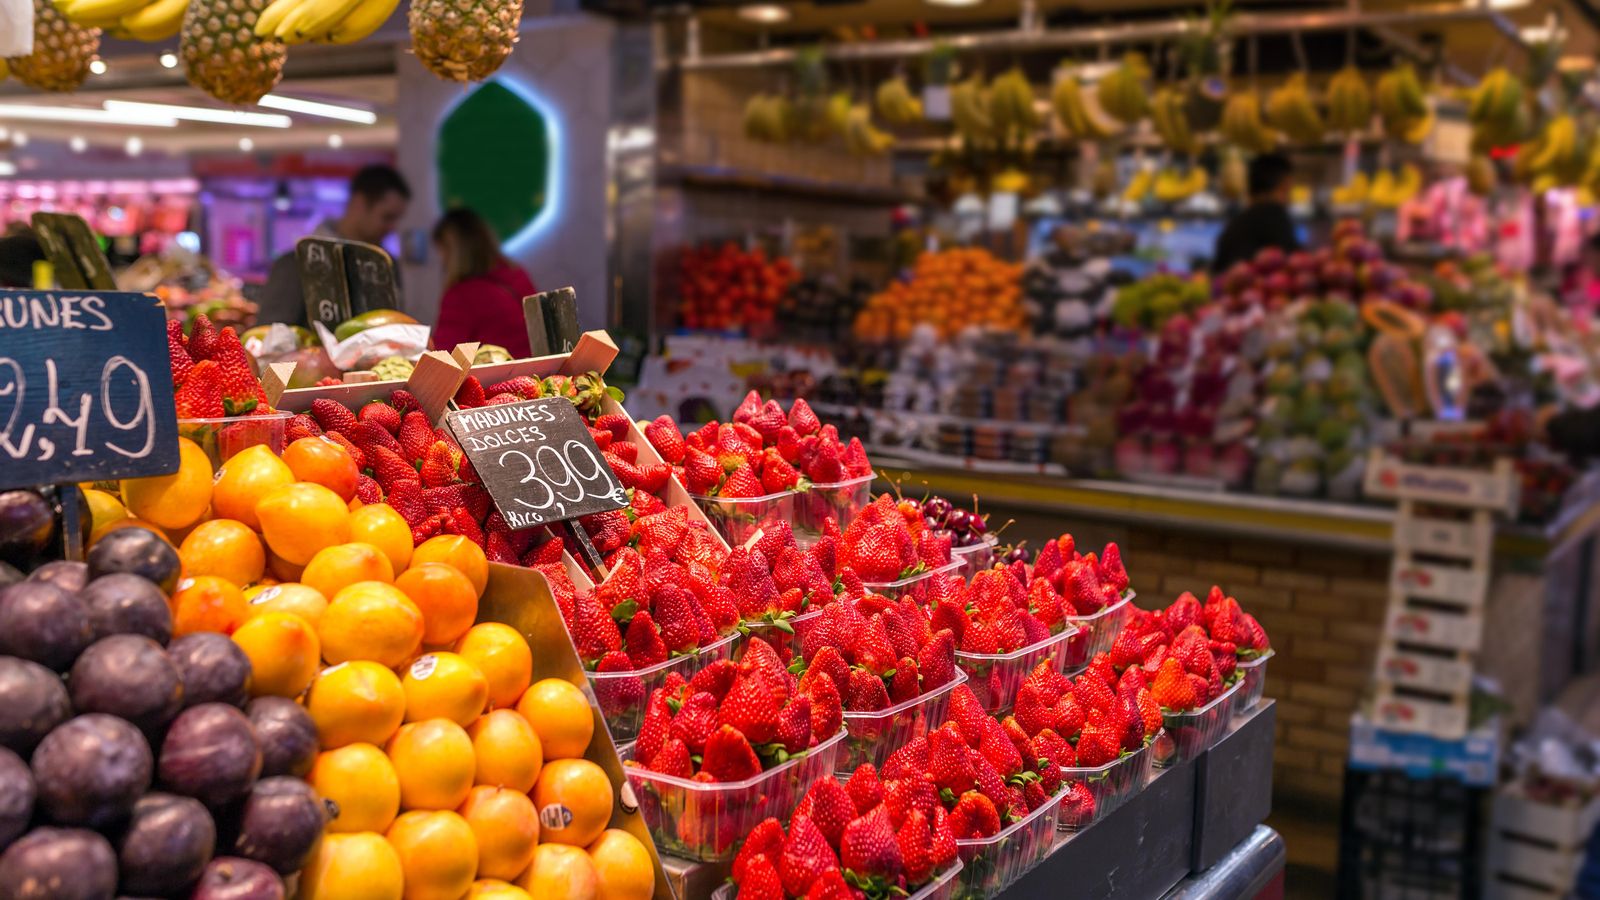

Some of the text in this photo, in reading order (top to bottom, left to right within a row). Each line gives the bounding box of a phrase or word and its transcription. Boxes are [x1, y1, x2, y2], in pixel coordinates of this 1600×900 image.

[0, 294, 114, 331] UNES
[0, 356, 156, 461] 2,49
[457, 404, 556, 433] MADUIXES
[467, 425, 547, 452] DOLCES
